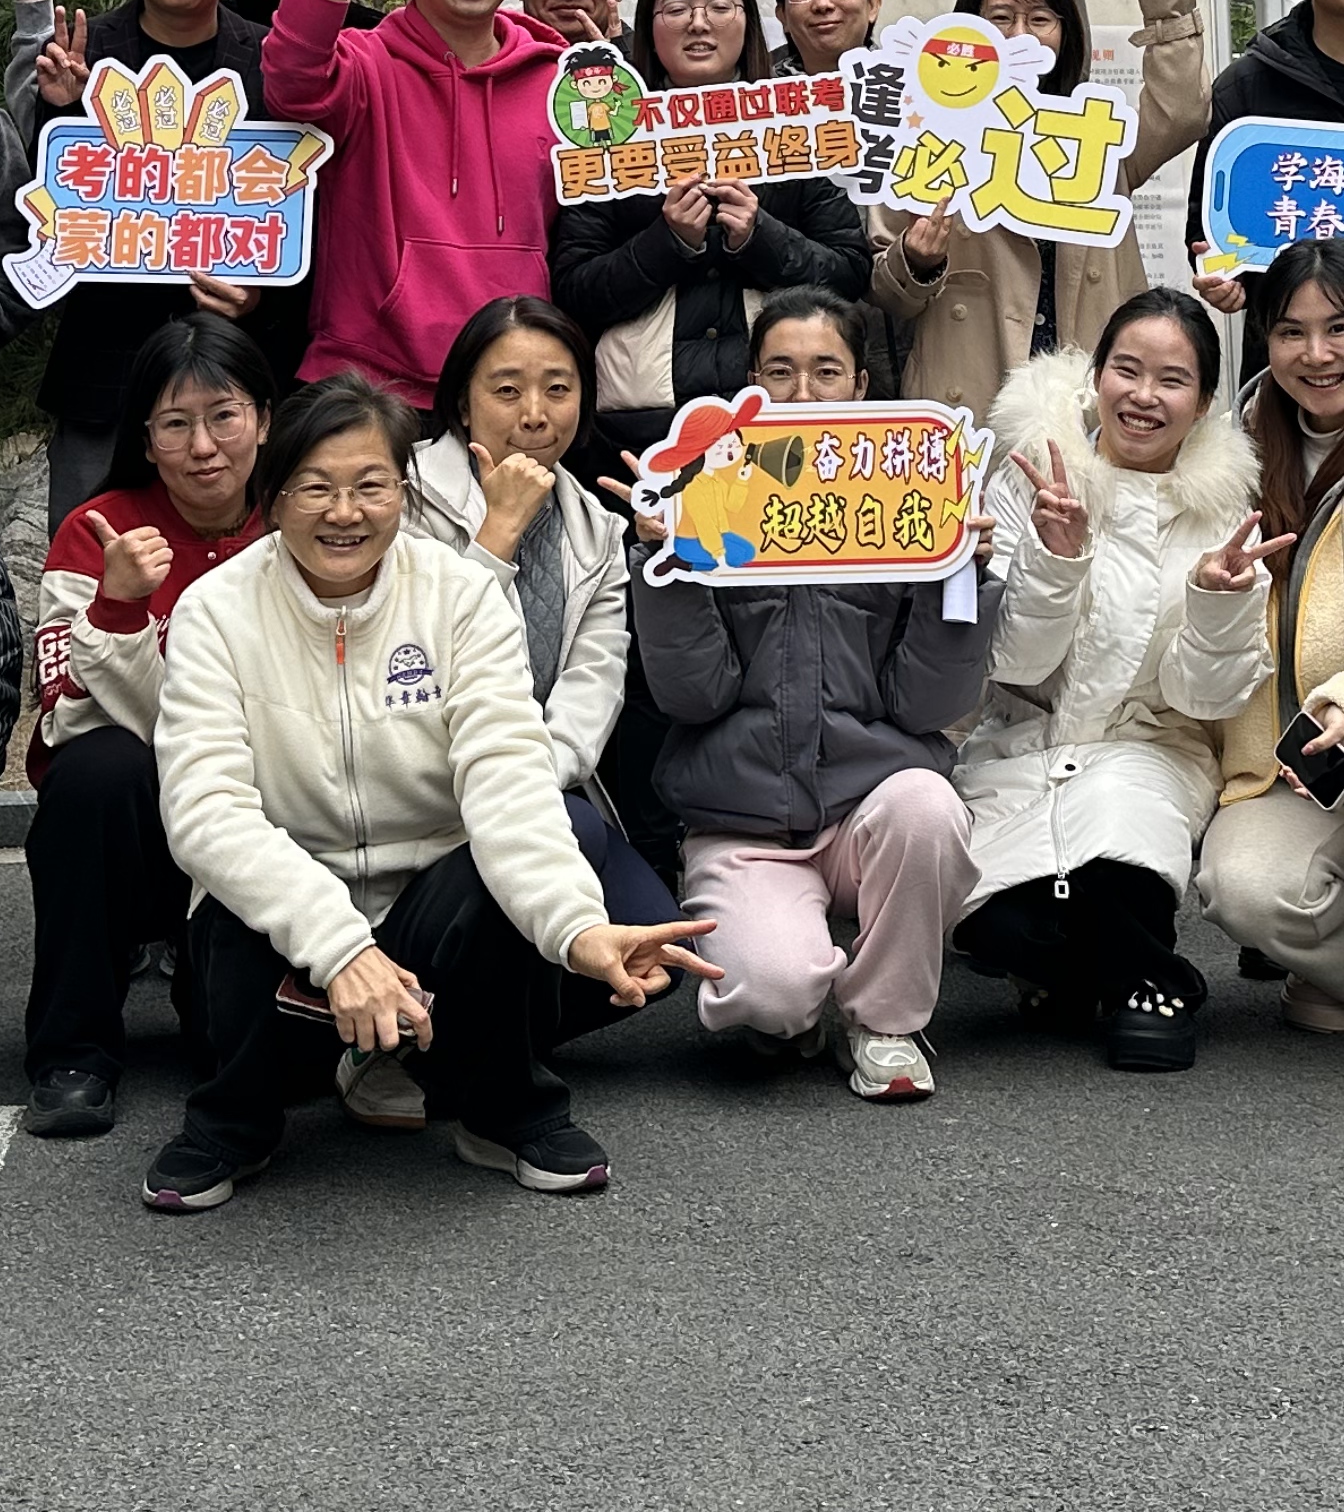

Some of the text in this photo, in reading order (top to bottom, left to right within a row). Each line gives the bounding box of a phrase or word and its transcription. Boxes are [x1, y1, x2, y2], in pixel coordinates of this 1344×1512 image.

[111, 88, 142, 135] 必过
[155, 85, 178, 130] 必过
[200, 97, 230, 142] 必过
[631, 77, 846, 132] 不仅通过联考
[58, 143, 288, 206] 考的都会
[556, 119, 862, 199] 更要受益终身
[53, 209, 287, 273] 蒙的都对
[813, 426, 950, 484] 奋力拼搏
[759, 488, 935, 554] 超越自我
